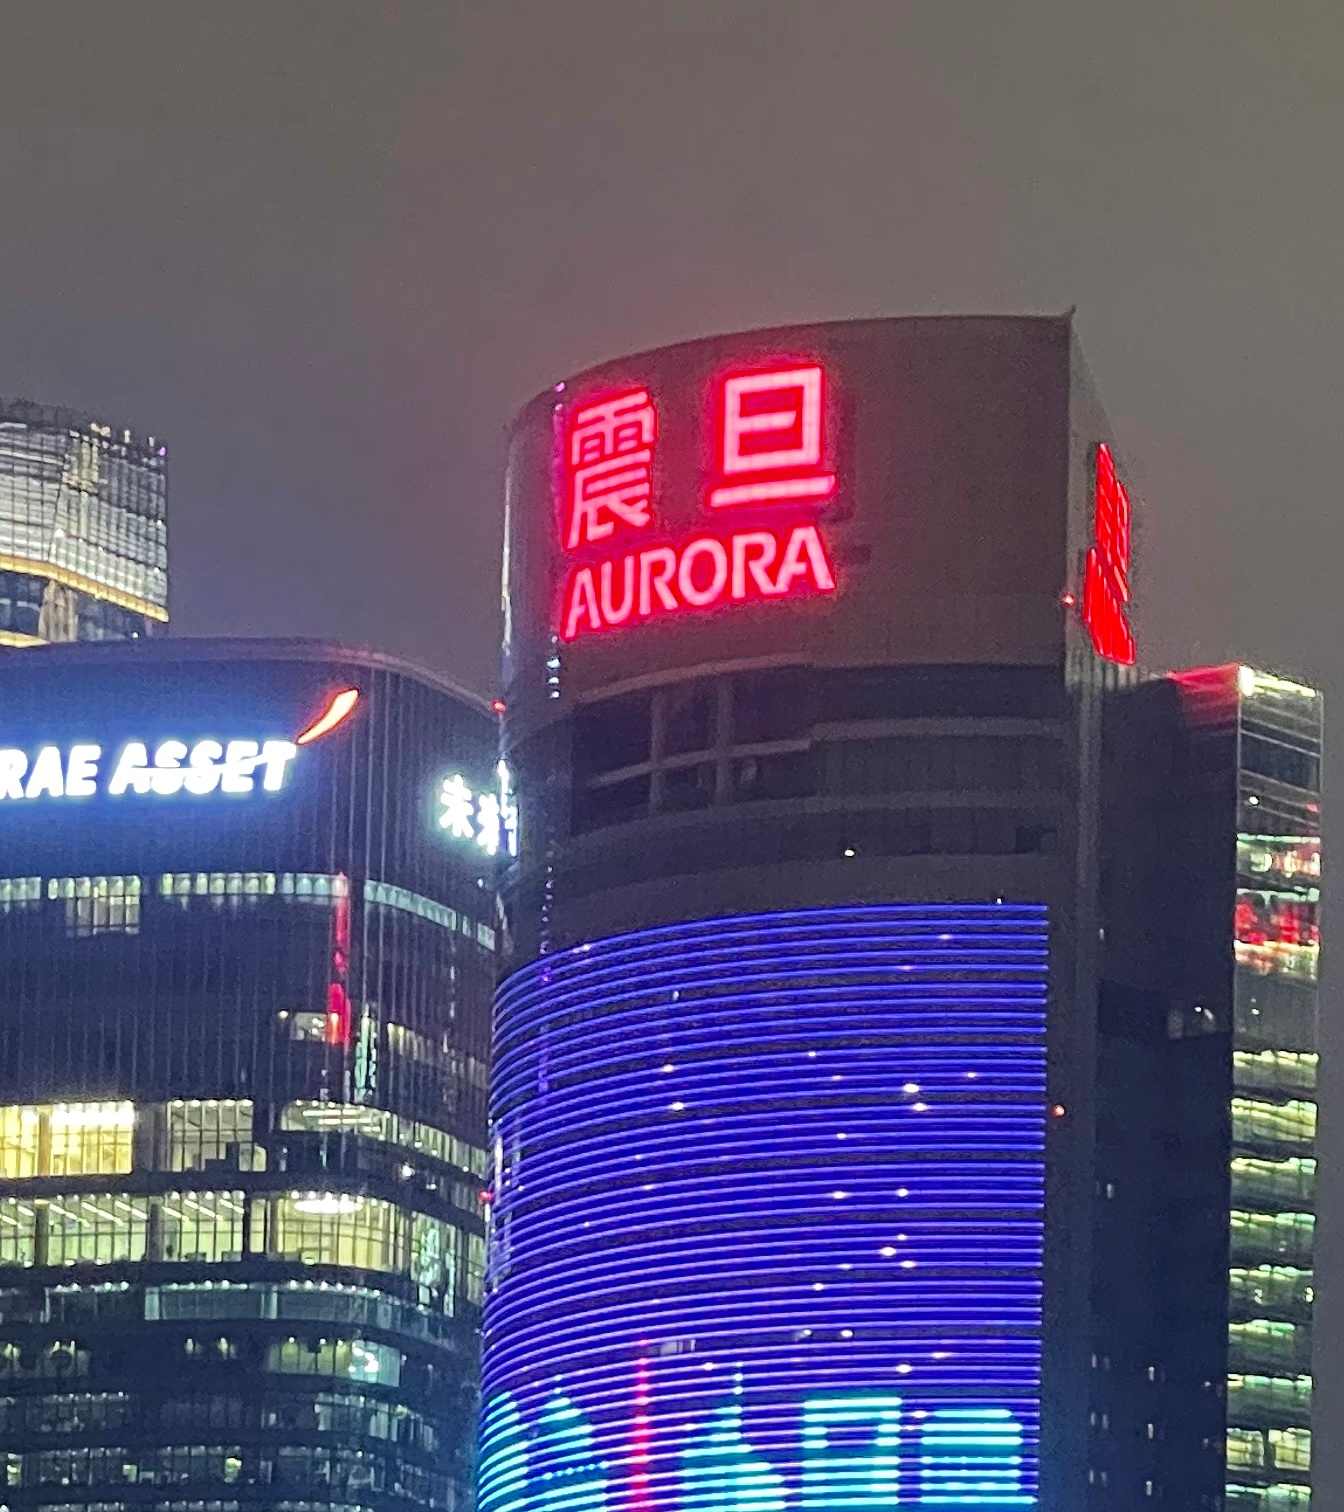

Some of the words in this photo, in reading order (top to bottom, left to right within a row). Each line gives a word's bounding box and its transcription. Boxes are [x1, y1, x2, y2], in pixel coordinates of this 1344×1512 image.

[564, 366, 838, 548] 震旦
[563, 525, 836, 641] AURORA
[109, 739, 297, 794] ASSET
